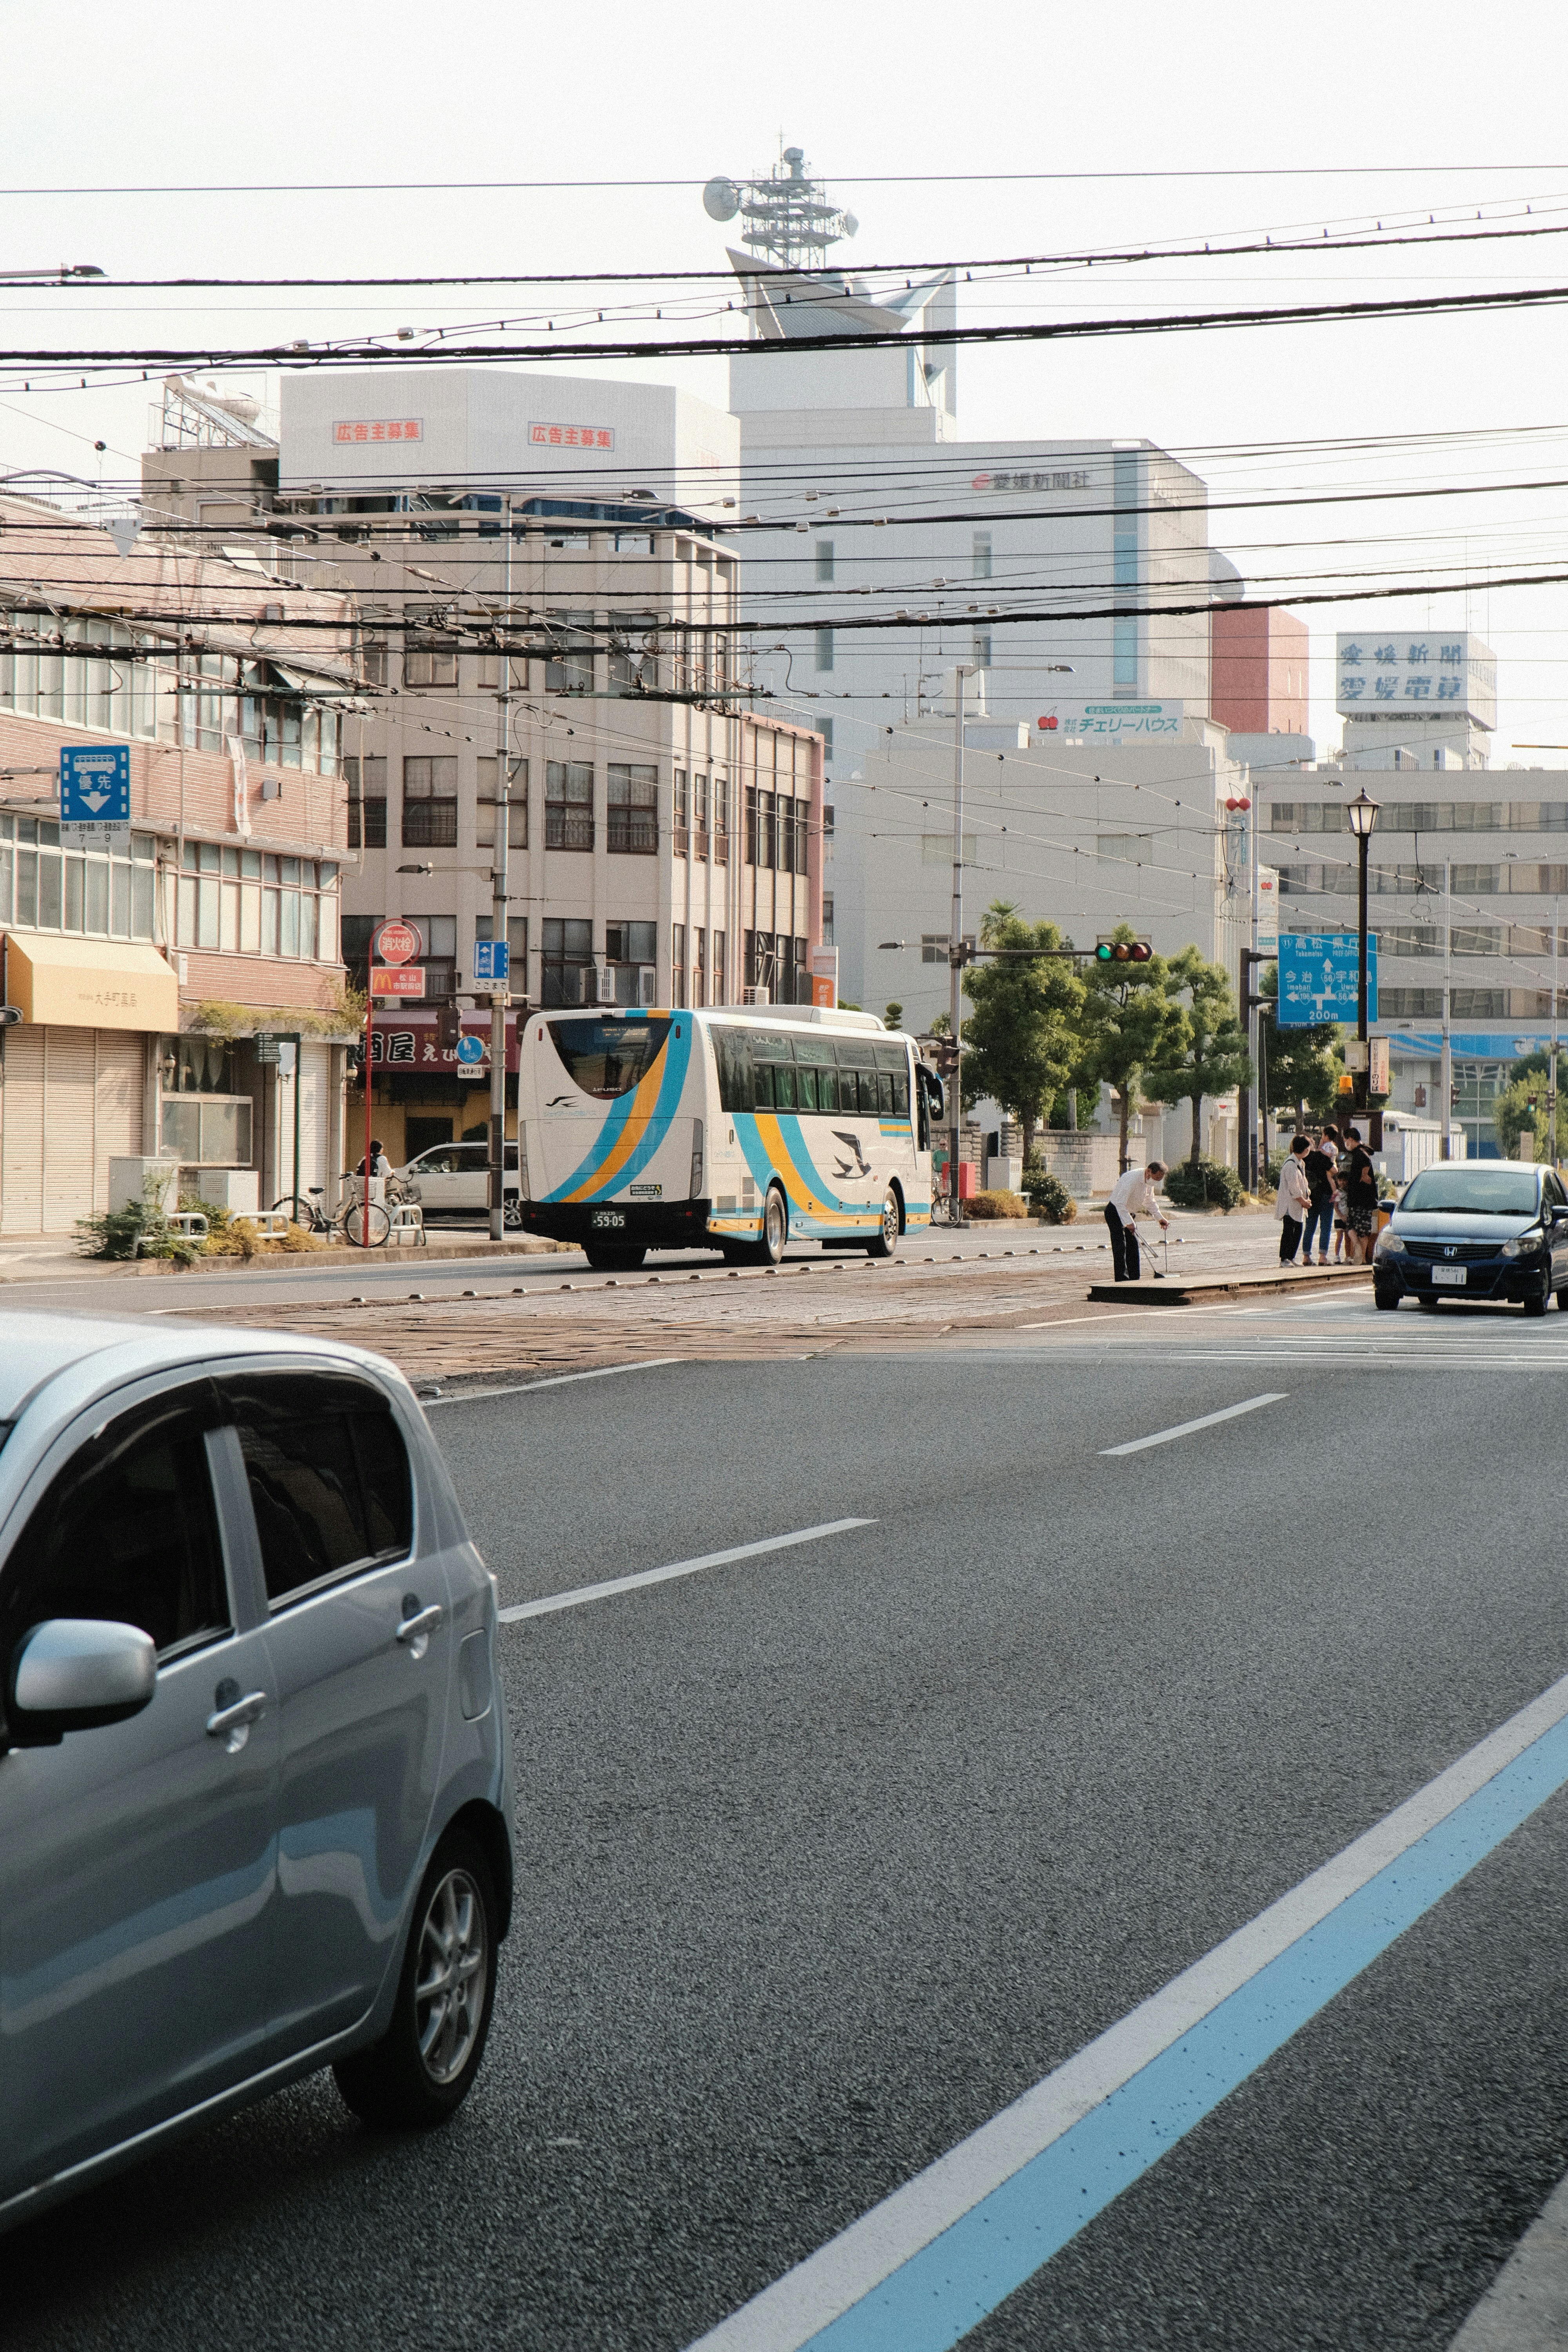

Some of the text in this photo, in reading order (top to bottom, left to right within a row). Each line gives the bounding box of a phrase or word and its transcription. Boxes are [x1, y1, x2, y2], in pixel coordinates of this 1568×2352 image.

[337, 422, 419, 441] 広告主募集
[533, 426, 611, 448] 広告主募集
[994, 471, 1089, 489] 愛媛新聞社
[1341, 643, 1461, 665] 愛媛新聞
[1080, 718, 1178, 732] チェリーハウス
[78, 775, 111, 789] 優先
[382, 937, 411, 951] 消火栓
[1296, 937, 1323, 949] 高松
[1285, 970, 1312, 983] 今治
[1309, 1011, 1338, 1020] 200m
[597, 1216, 624, 1227] 59-05
